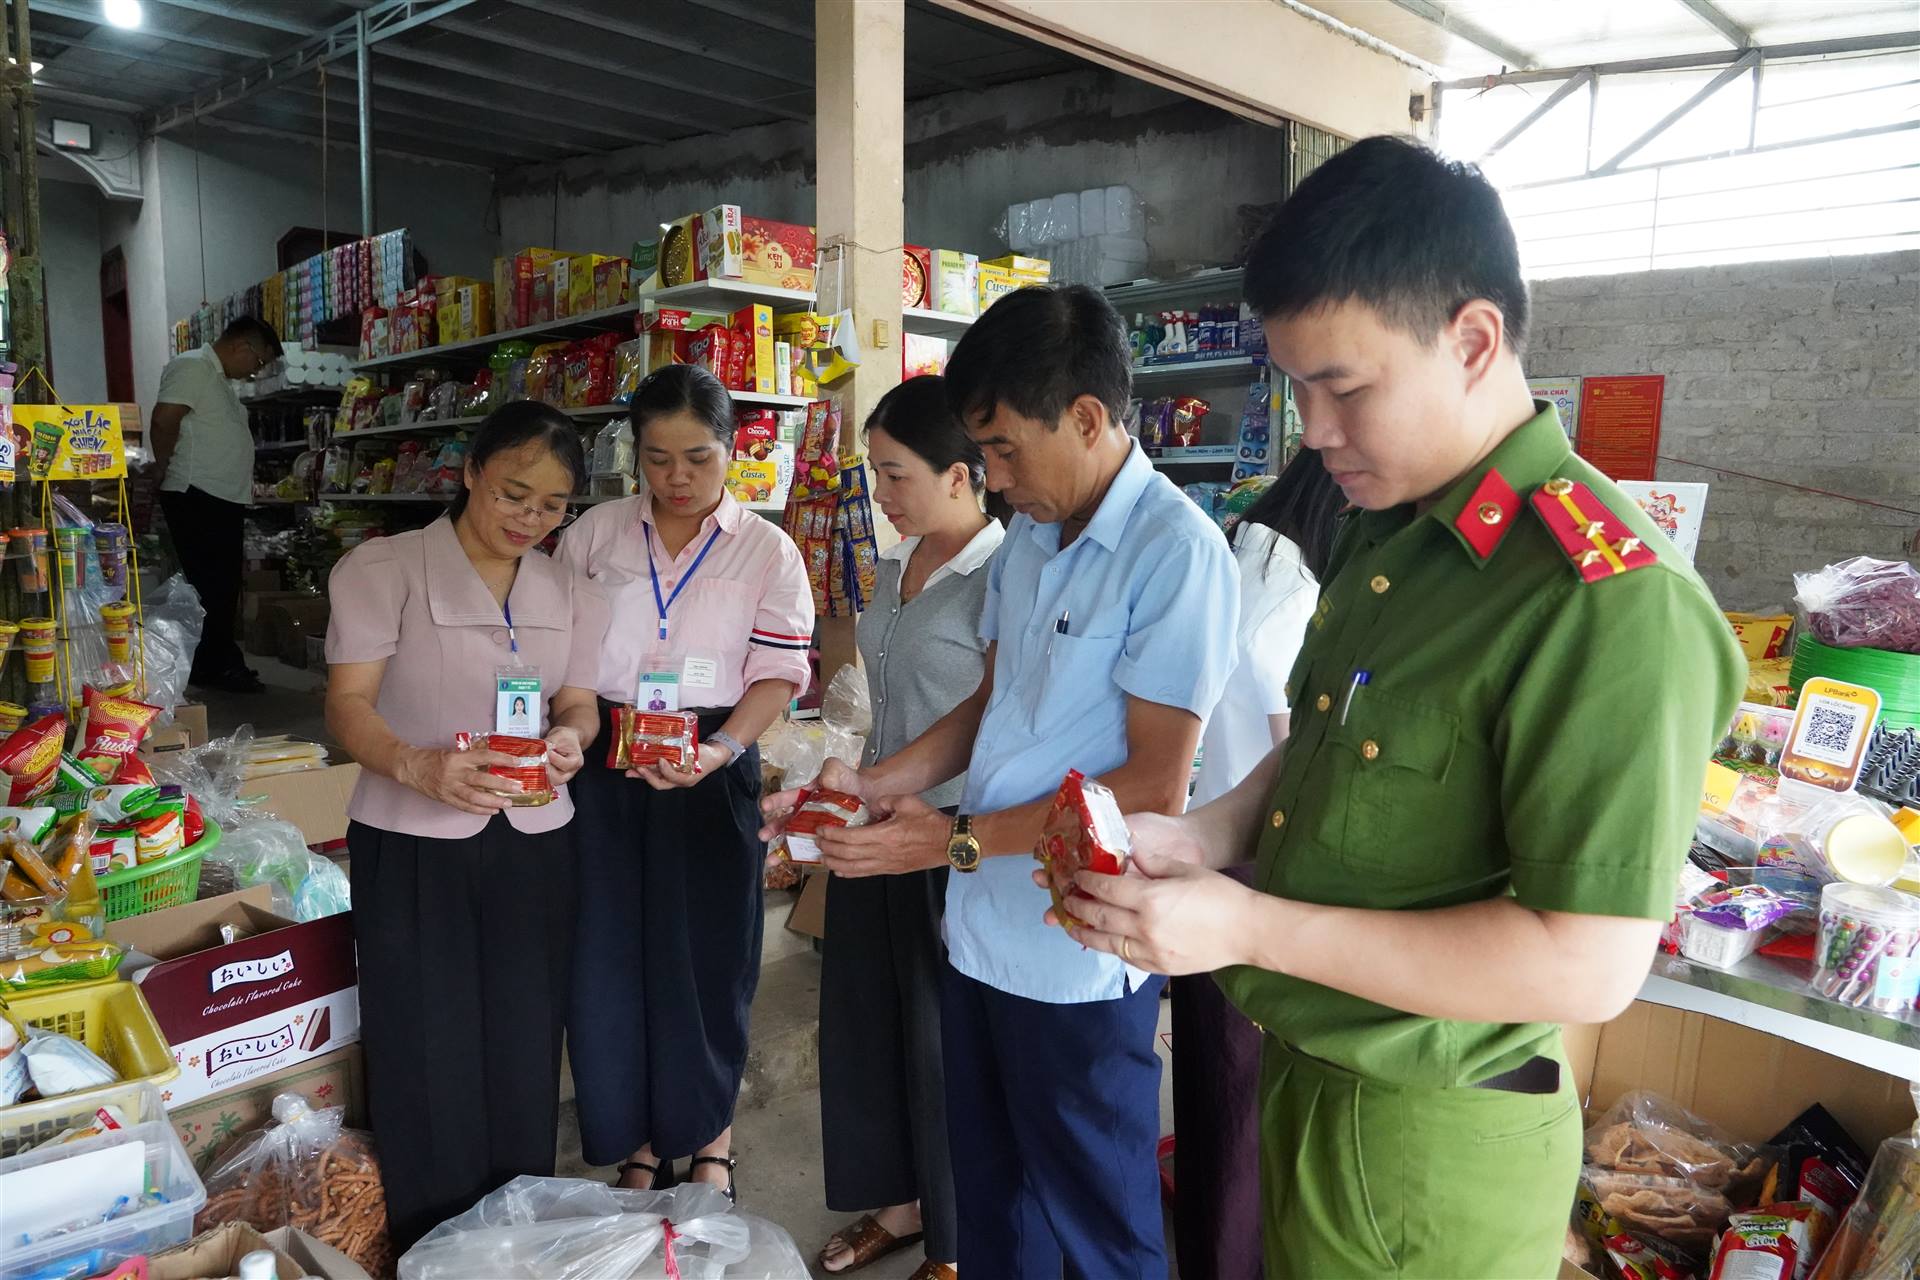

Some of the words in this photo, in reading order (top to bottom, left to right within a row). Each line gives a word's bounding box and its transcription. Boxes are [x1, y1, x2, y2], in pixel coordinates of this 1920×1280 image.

[985, 279, 1016, 293] Custa
[740, 470, 766, 478] Custas
[1824, 687, 1851, 698] LPBank
[220, 958, 286, 982] おいしい
[202, 997, 242, 1015] Chocolate
[245, 984, 281, 1004] Flavored
[283, 978, 302, 990] Cake
[219, 1034, 285, 1062] おいしい
[211, 1071, 242, 1087] Chocolate
[242, 1060, 270, 1078] Flavored
[272, 1055, 286, 1067] Cake
